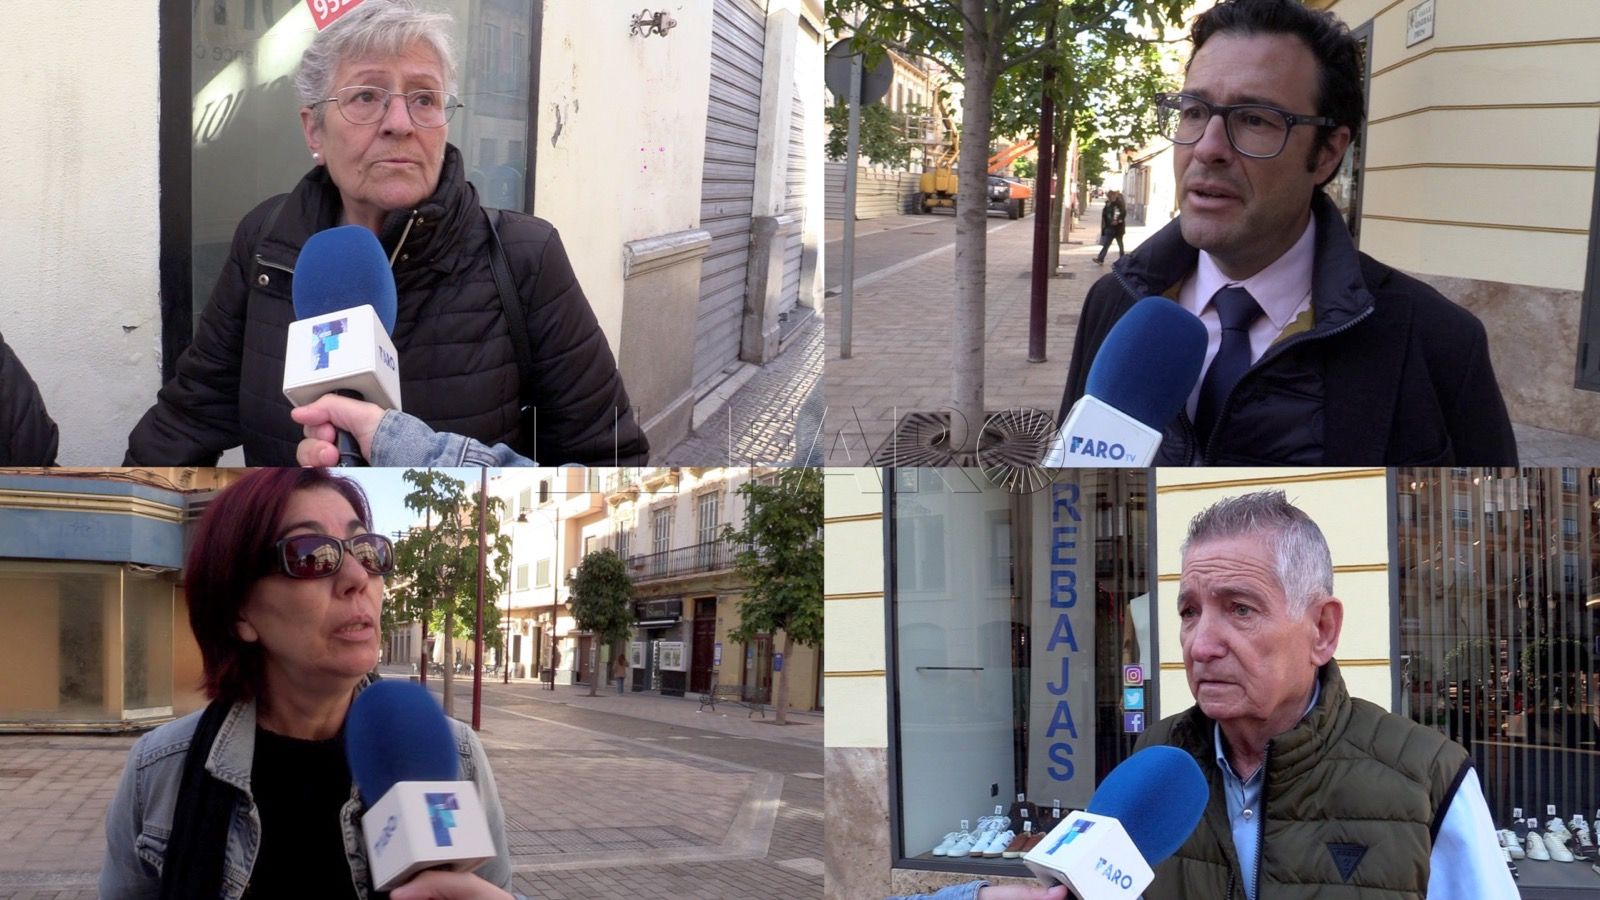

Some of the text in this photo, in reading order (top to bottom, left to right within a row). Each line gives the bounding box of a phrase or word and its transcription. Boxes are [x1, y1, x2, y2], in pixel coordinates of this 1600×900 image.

[1070, 436, 1136, 463] FARO TV
[1046, 483, 1082, 782] REBAJAS
[1094, 856, 1133, 890] FARO
